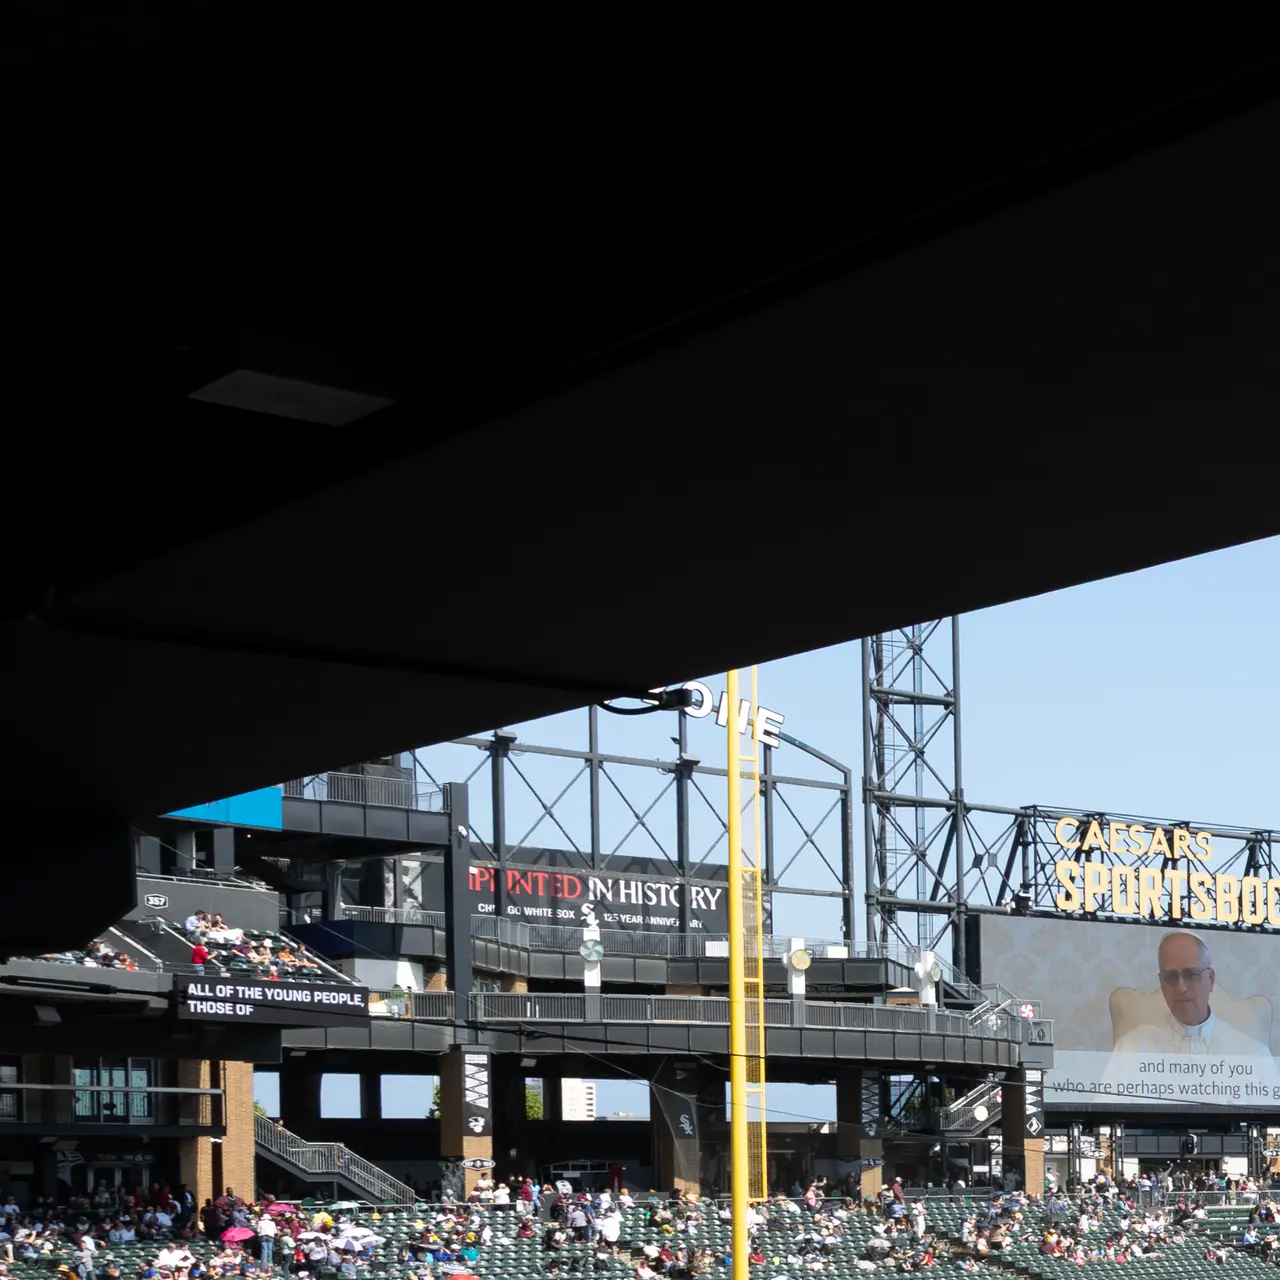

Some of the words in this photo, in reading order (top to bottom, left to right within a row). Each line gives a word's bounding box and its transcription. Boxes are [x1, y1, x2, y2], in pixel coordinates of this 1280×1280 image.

[1055, 817, 1213, 862] CAESARS
[588, 877, 613, 902] IN
[147, 896, 166, 906] 357
[524, 907, 553, 918] WHITE
[556, 909, 575, 919] SOX
[620, 914, 643, 925] YEAR
[188, 983, 213, 996] ALL
[216, 984, 234, 998] OF
[236, 986, 263, 1000] THE
[264, 988, 311, 1002] YOUNG
[314, 991, 365, 1007] PEOPLE,
[188, 1000, 233, 1015] THOSE
[236, 1003, 253, 1016] OF
[1139, 1059, 1165, 1073] and
[1169, 1061, 1206, 1077] many
[1210, 1060, 1226, 1075] of
[1228, 1063, 1253, 1077] you
[1053, 1077, 1085, 1093] who
[1089, 1081, 1112, 1093] are
[1117, 1080, 1174, 1098] perhaps
[1178, 1082, 1241, 1099] watching
[1244, 1082, 1269, 1096] this
